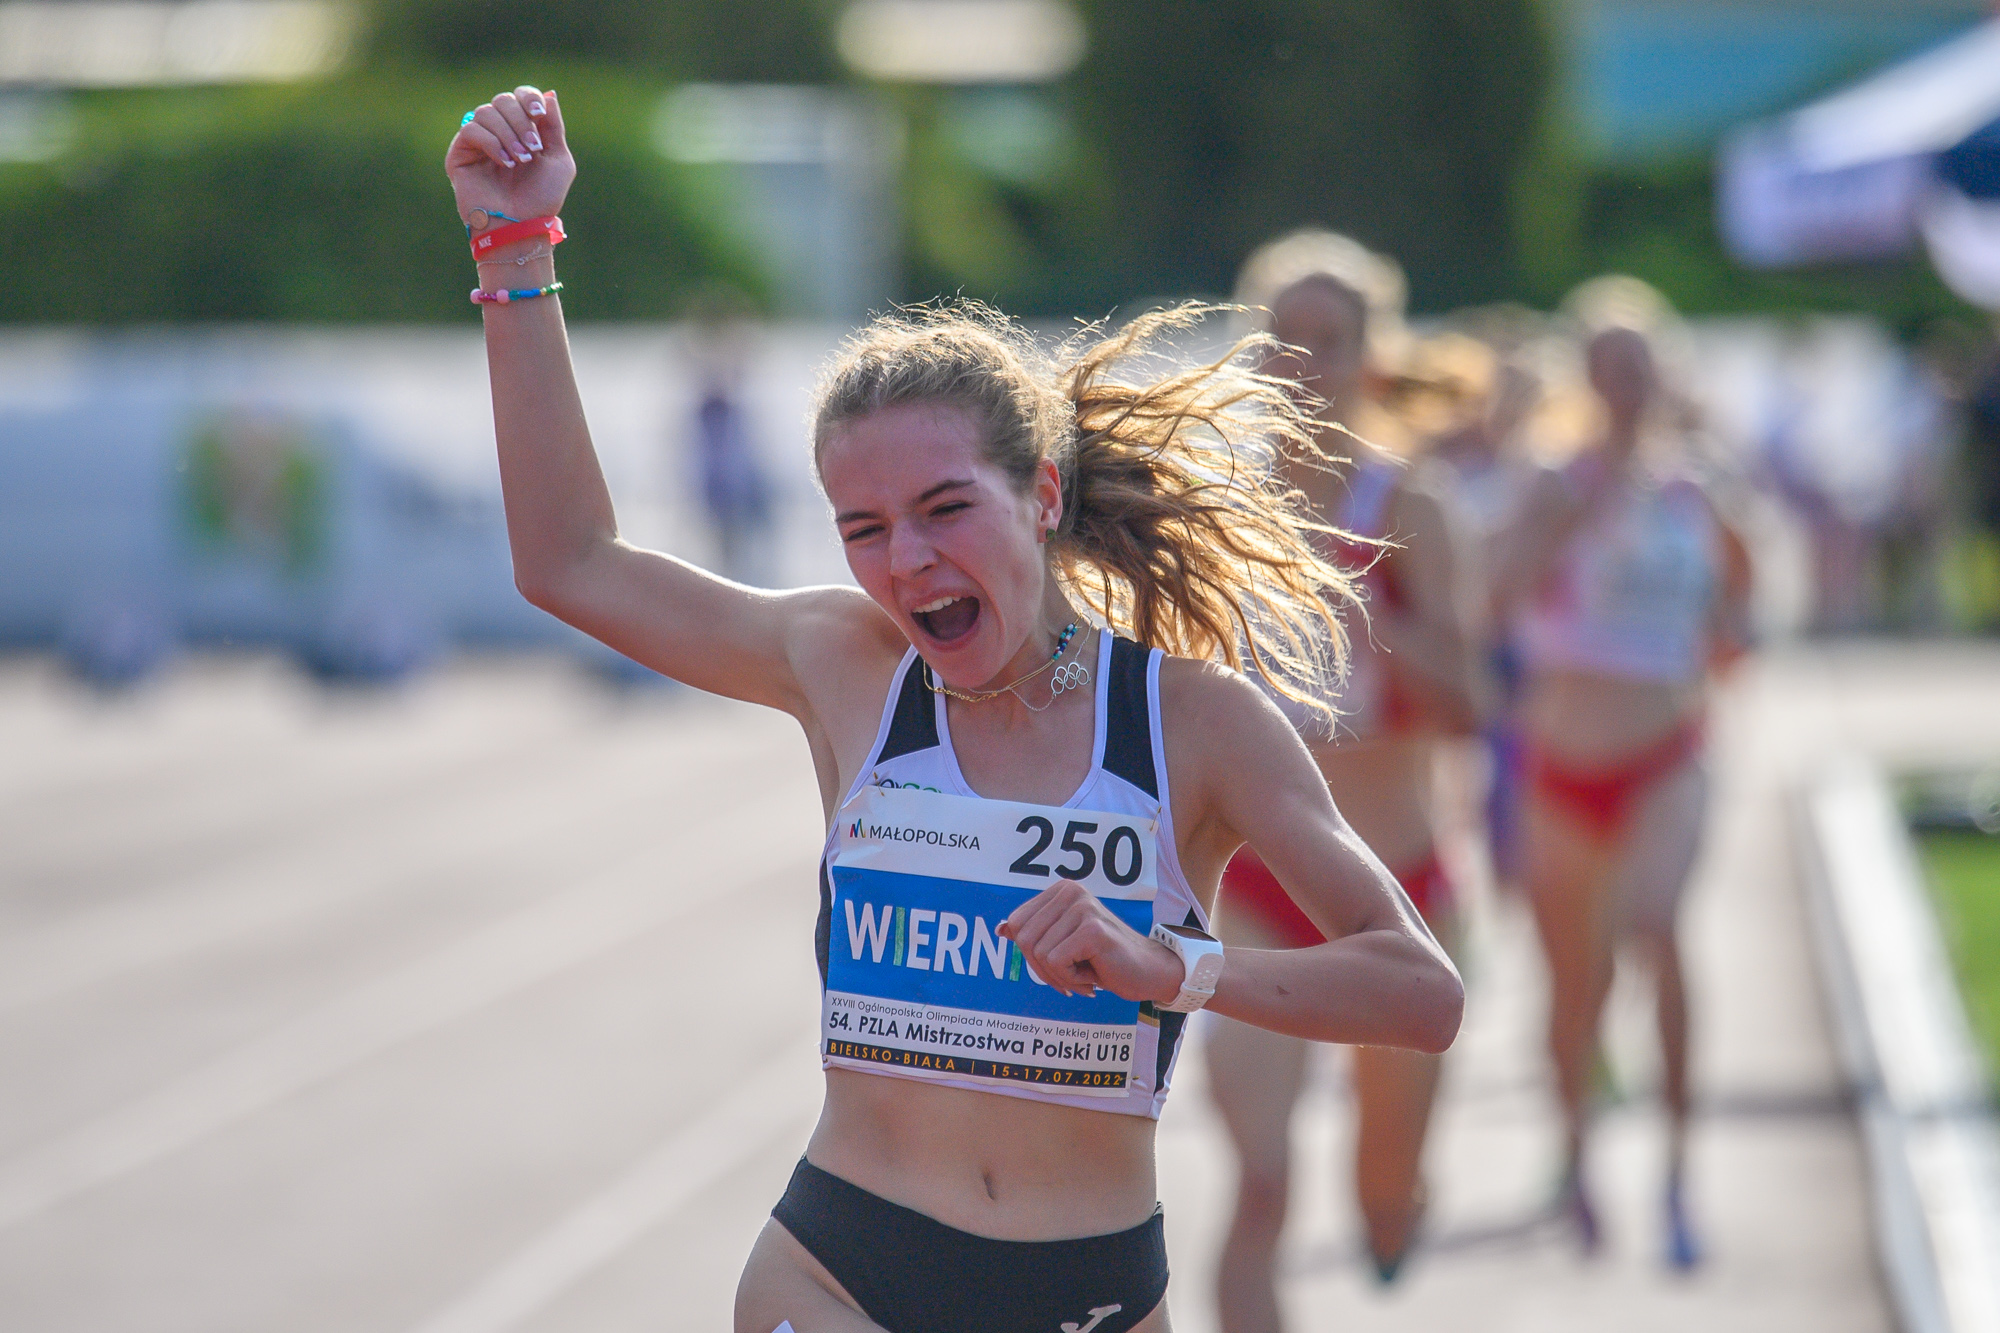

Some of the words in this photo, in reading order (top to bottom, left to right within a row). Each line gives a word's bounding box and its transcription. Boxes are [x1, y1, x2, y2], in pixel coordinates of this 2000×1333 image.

[869, 825, 981, 851] MAŁOPOLSKA
[1009, 815, 1143, 887] 250
[829, 1011, 853, 1032] 54.
[858, 1015, 899, 1039] PZLA
[904, 1022, 1025, 1055] Mistrzostwa
[1032, 1038, 1092, 1061] Polski
[1096, 1043, 1131, 1062] U18
[831, 997, 856, 1009] XXVIII
[857, 1001, 923, 1018] Ogólnopolska
[926, 1011, 983, 1025] Olimpiada
[986, 1019, 1041, 1035] Młodzieży
[1043, 1027, 1054, 1035] w
[1055, 1027, 1090, 1041] lekkiej
[1092, 1030, 1133, 1042] atletyce
[830, 1042, 955, 1071] BIELSKO-BIAŁA
[991, 1064, 1122, 1086] 15-17.07.2022
